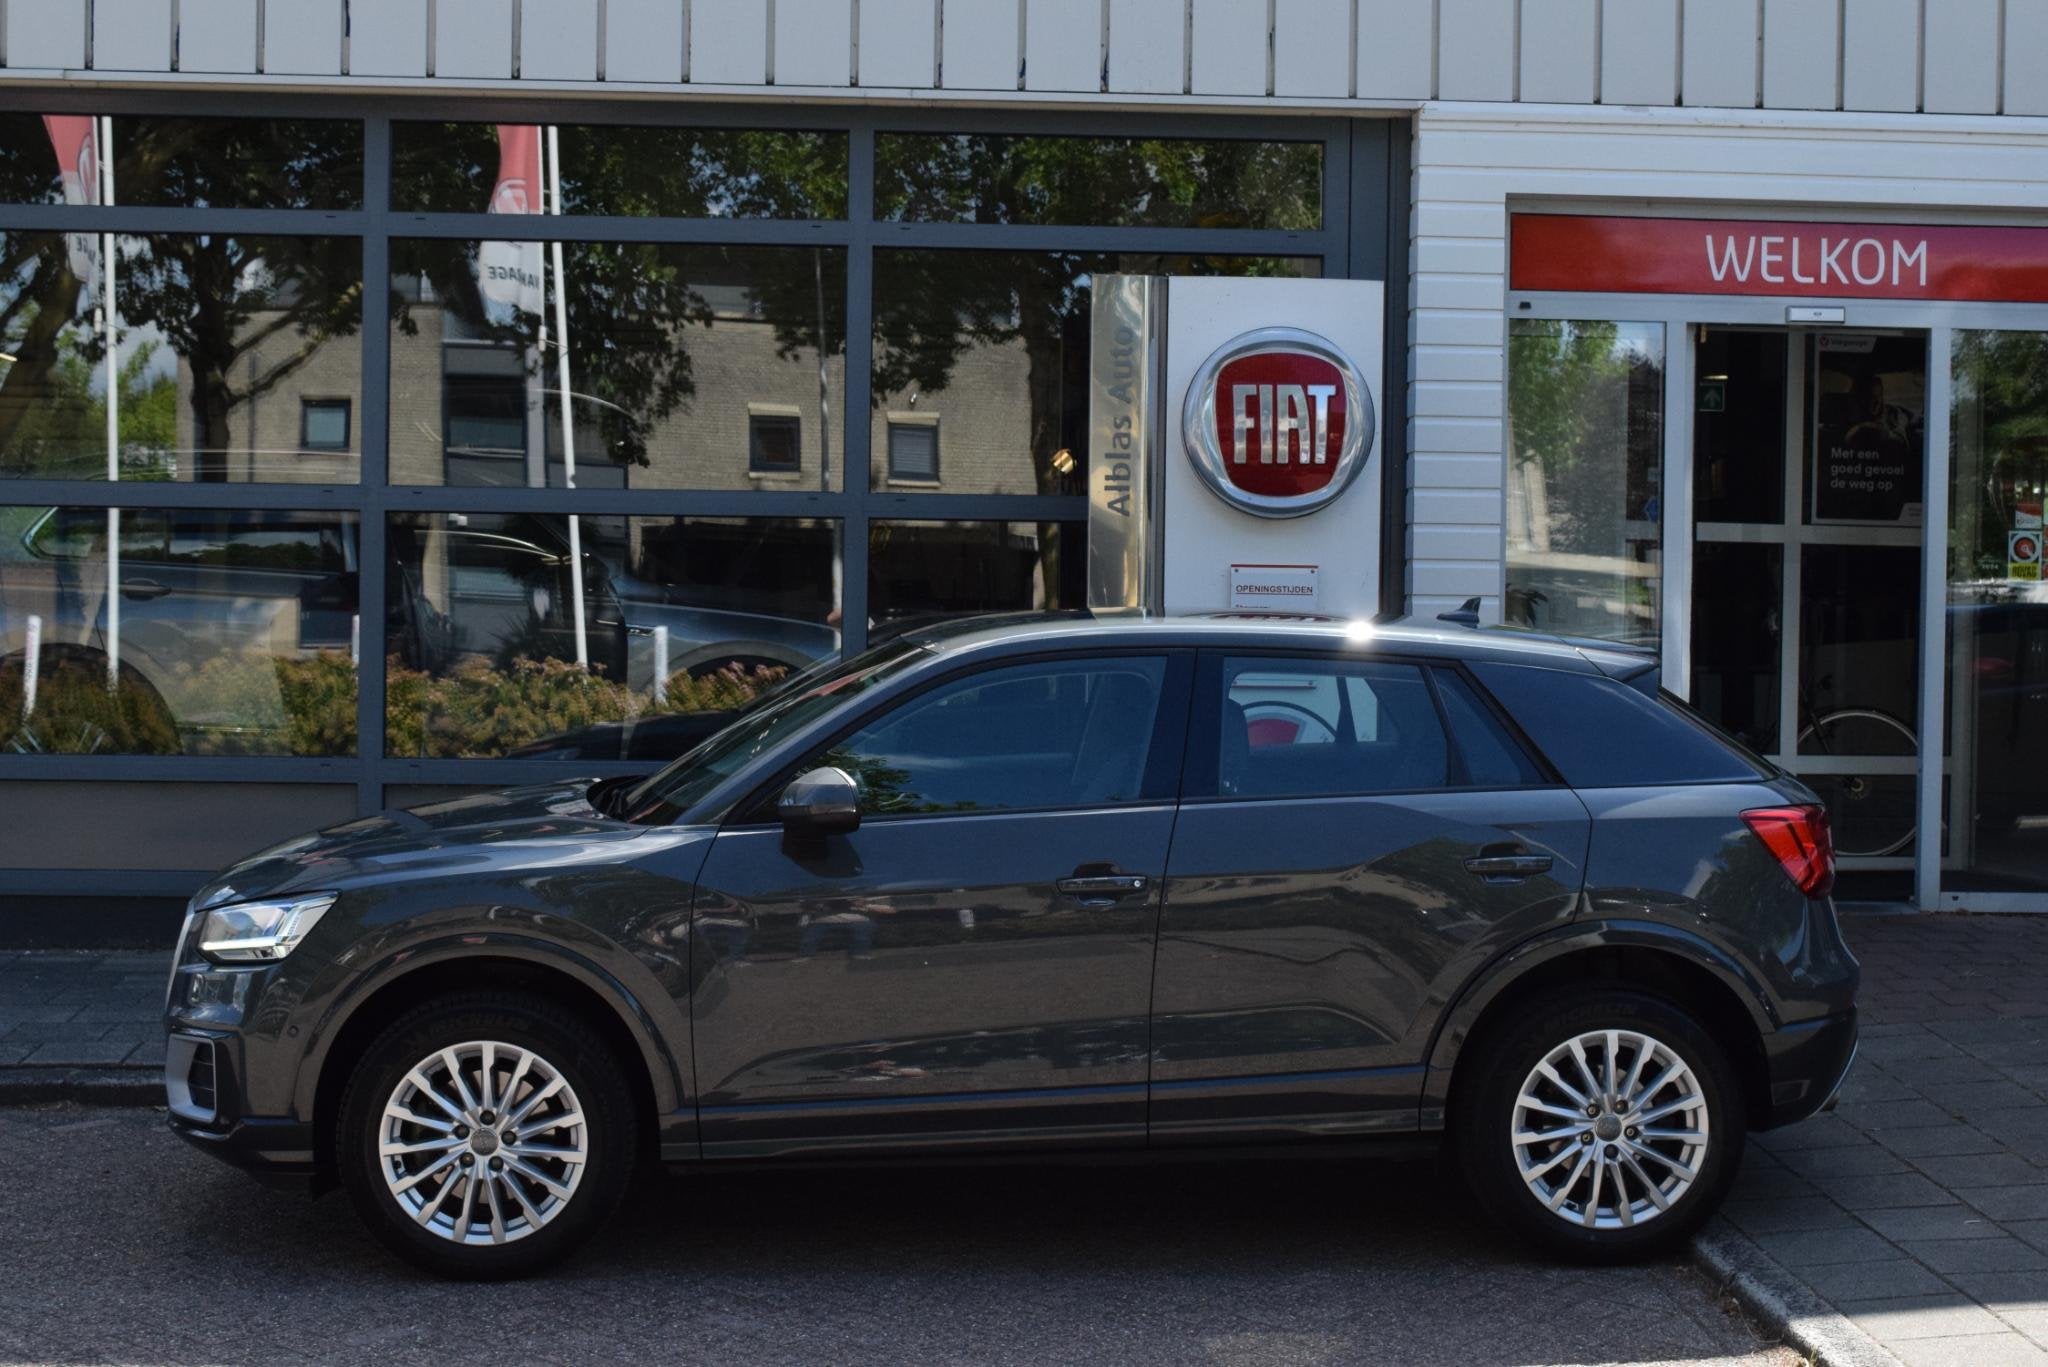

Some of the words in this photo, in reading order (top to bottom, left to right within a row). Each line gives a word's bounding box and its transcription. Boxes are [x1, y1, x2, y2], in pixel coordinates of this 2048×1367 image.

[1705, 234, 1927, 287] WELKOM
[1107, 325, 1132, 404] Auto
[1232, 383, 1336, 465] FIAT
[1104, 415, 1131, 518] Alblas
[1831, 447, 1853, 459] Met
[1857, 449, 1880, 460] een
[1830, 477, 1846, 489] de
[1849, 480, 1874, 493] weg
[1877, 481, 1893, 493] op
[1831, 464, 1862, 477] goed
[1865, 464, 1905, 478] gevoel
[1235, 585, 1313, 593] OPENINGSTIJDEN
